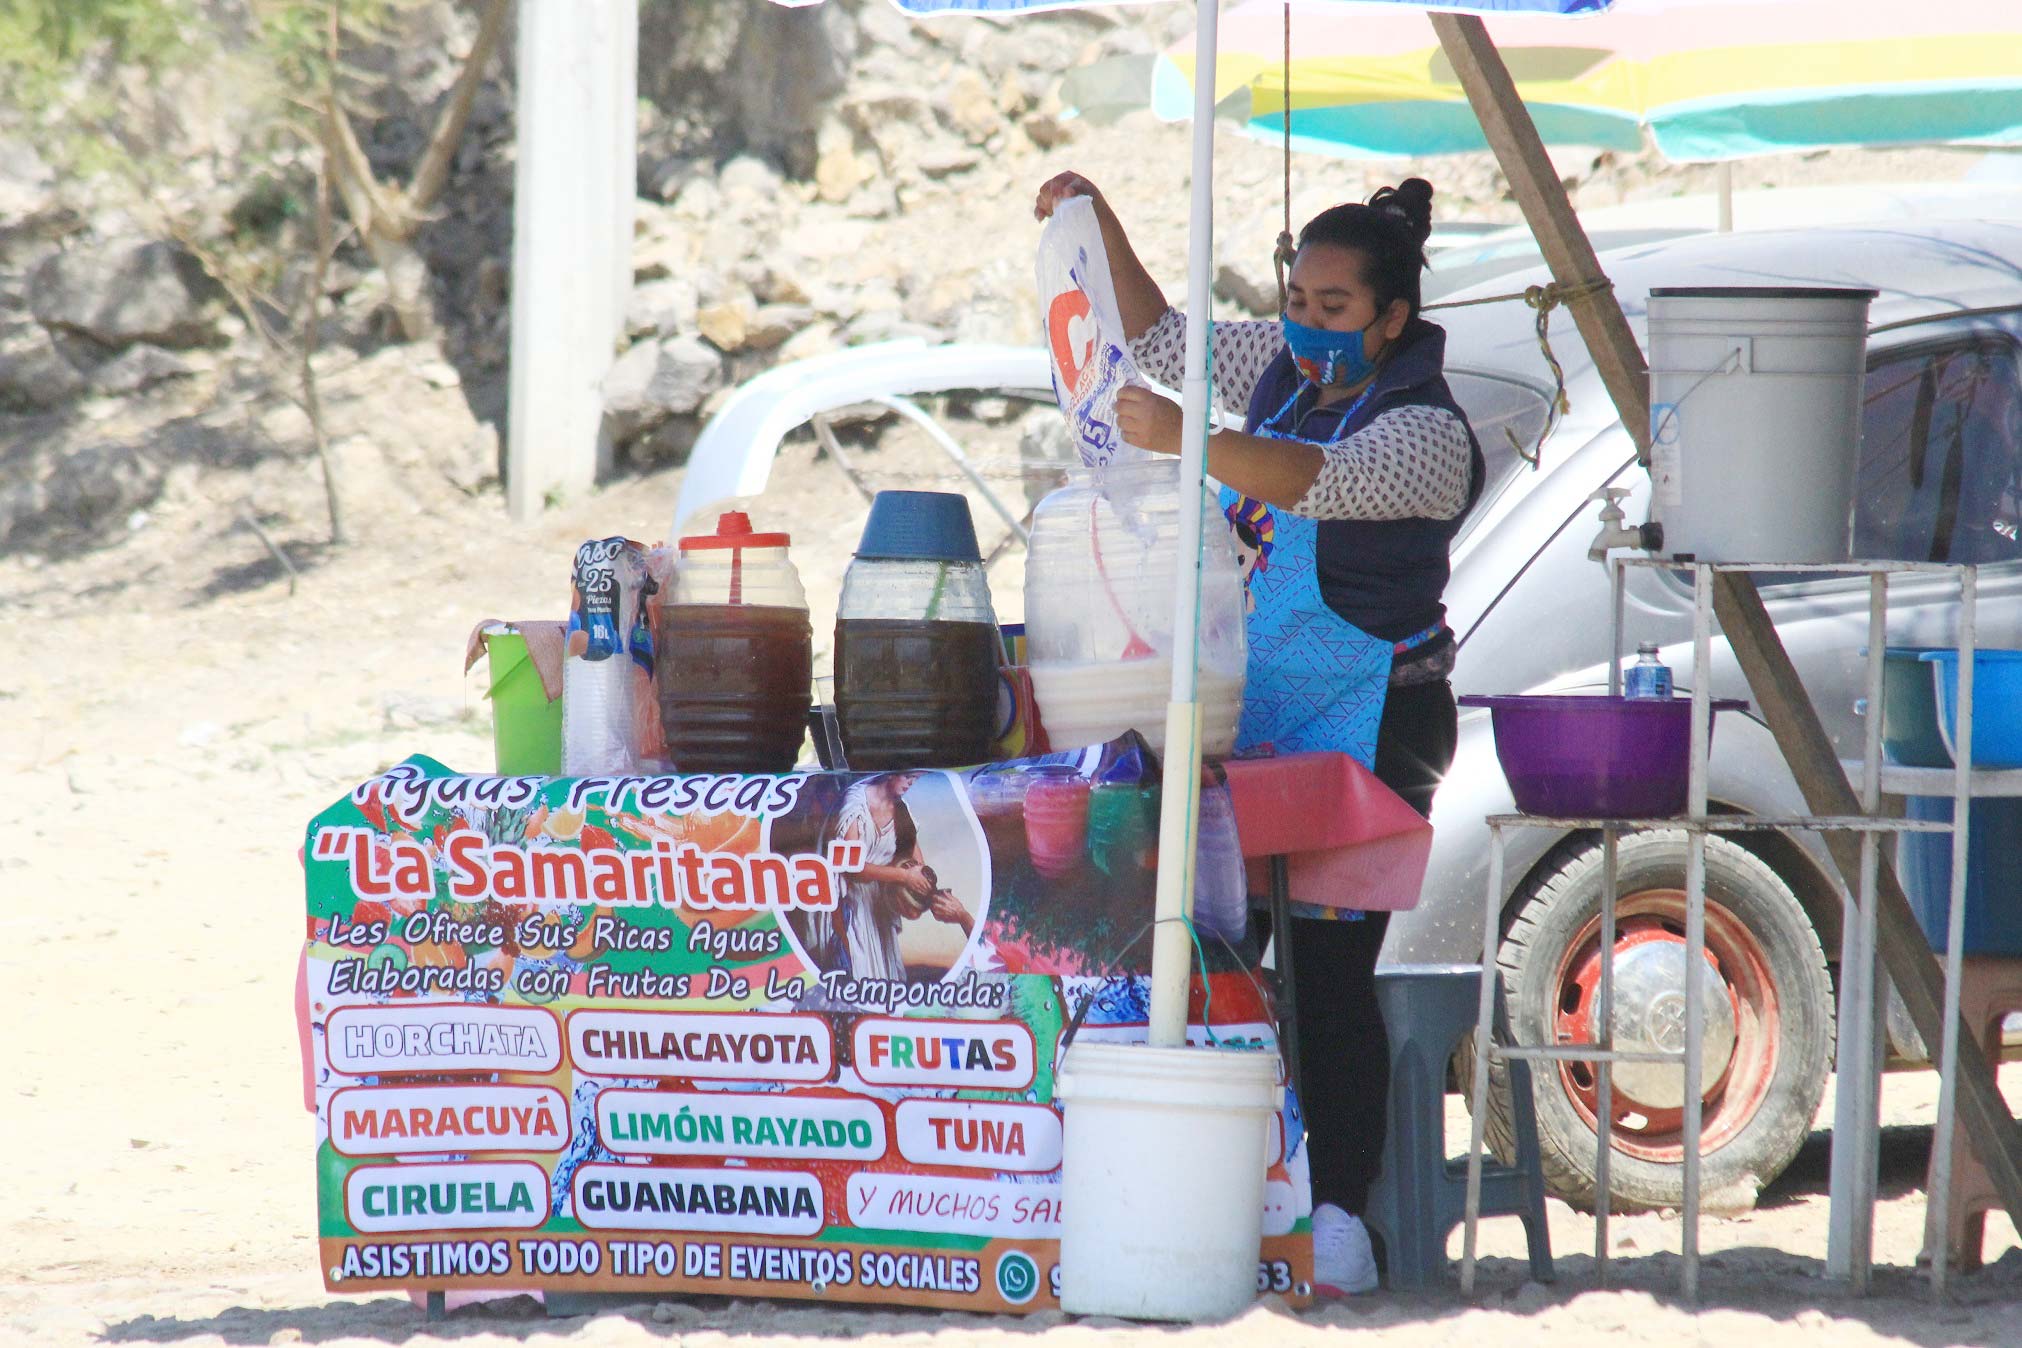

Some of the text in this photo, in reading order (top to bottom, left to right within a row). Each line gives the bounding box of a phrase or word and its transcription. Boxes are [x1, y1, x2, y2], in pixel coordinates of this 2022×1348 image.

[586, 569, 612, 592] 25
[586, 594, 612, 604] Piezas
[447, 835, 862, 908] Samaritana"
[329, 911, 780, 960] Les Ofrece Sus Ricas Aguas
[328, 959, 1004, 1009] Elaboradas con Frutas De La Temporada:
[345, 1022, 548, 1059] HORCHATA
[582, 1028, 820, 1066] CHILACAYOTA
[869, 1034, 1017, 1073] FRUTAS
[343, 1095, 560, 1140] MARACUYÁ
[609, 1104, 874, 1149] LIMÓN RAYADO
[928, 1117, 1027, 1157] TUNA
[361, 1181, 535, 1218] CIRUELA
[581, 1180, 818, 1219] GUANABANA
[859, 1186, 878, 1216] Y
[888, 1189, 1000, 1223] MUCHOS
[343, 1240, 981, 1292] ASISTIMOS TODO TIPO DE EVENTOS SOCIALES
